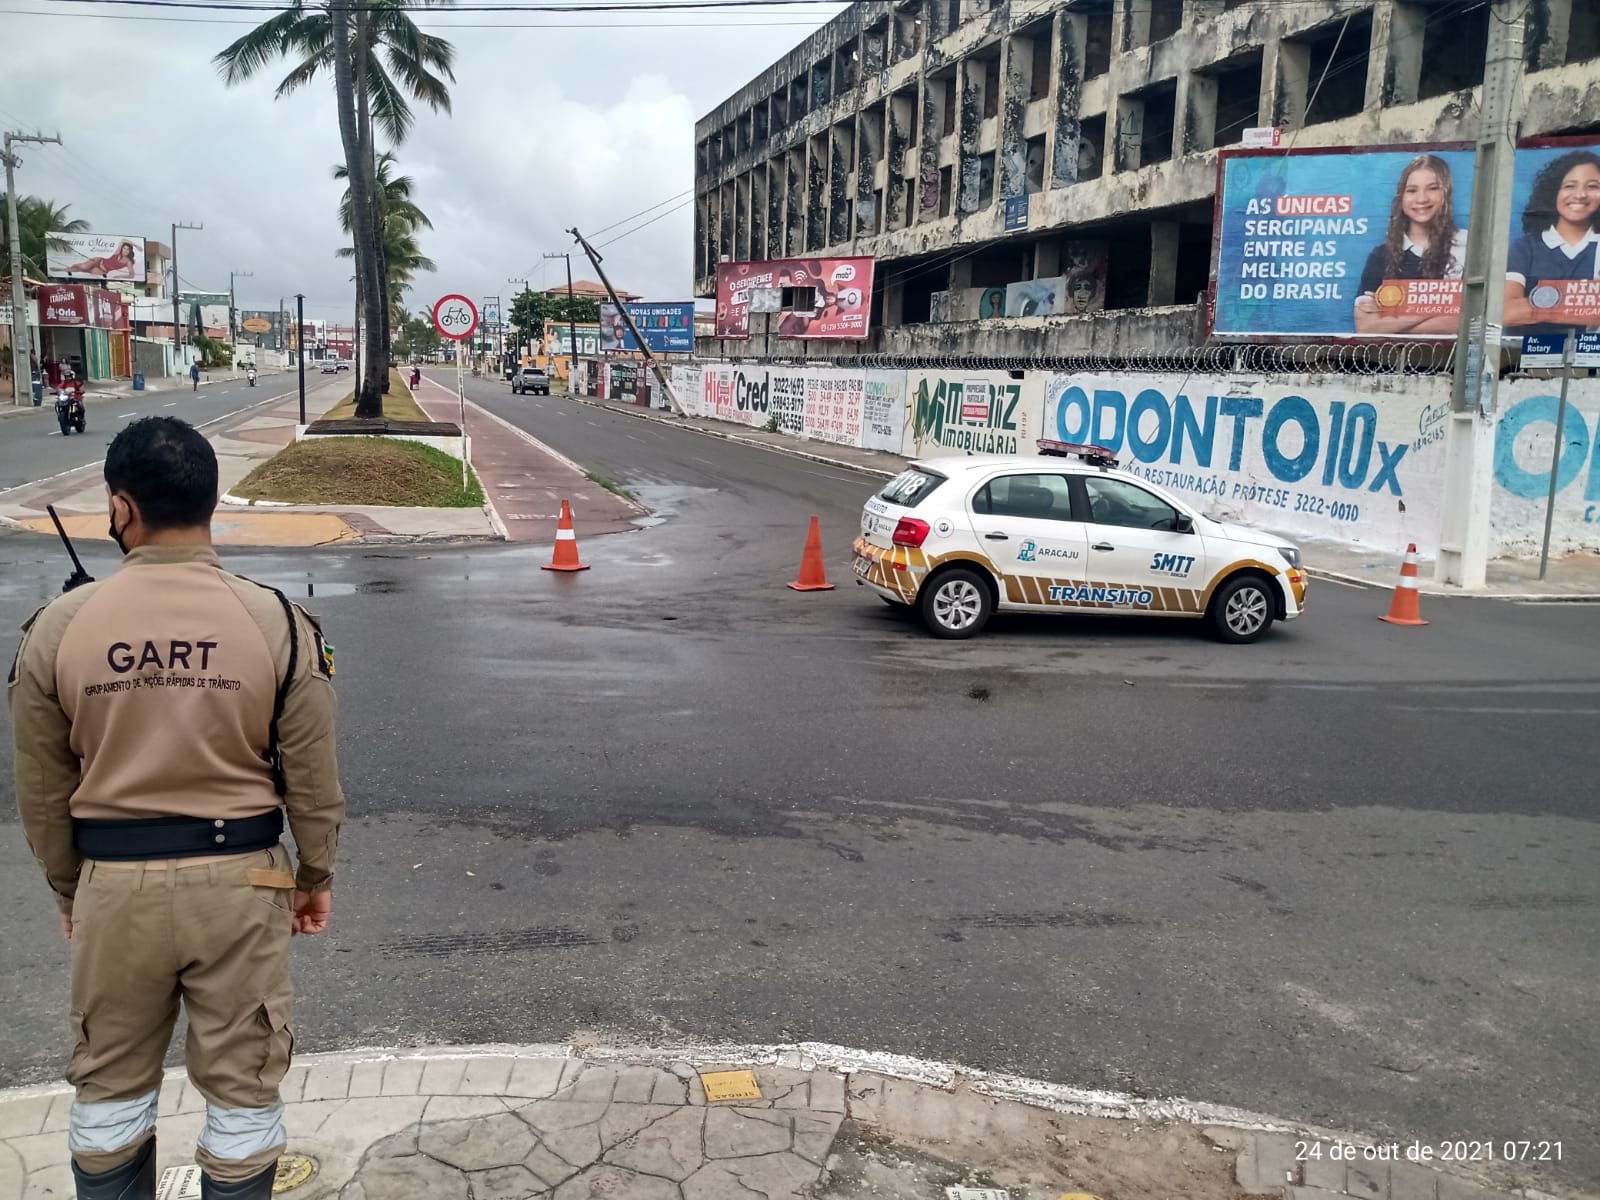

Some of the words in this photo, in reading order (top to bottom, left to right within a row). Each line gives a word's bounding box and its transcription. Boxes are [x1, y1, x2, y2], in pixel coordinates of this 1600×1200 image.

[1246, 198, 1272, 215] AS
[1277, 195, 1351, 214] ÚNICAS
[1245, 218, 1368, 236] SERGIPANAS
[1244, 240, 1305, 257] ENTRE
[1311, 240, 1336, 257] AS
[1241, 261, 1346, 278] MELHORES
[1240, 283, 1268, 300] DO
[1273, 282, 1342, 300] BRASIL
[1407, 294, 1453, 304] DAMM
[1528, 336, 1540, 344] Av.
[1579, 333, 1598, 342] José
[1527, 345, 1551, 354] Rotary
[942, 427, 1017, 454] IMOBILIÁRIA
[1144, 466, 1226, 496] RESTAURAÇÃO
[1232, 481, 1289, 508] PRÓTESE
[1294, 493, 1359, 521] 3222-0010
[1038, 547, 1079, 560] ARACAJU
[1150, 552, 1196, 573] SMTT
[1050, 584, 1153, 605] TRÂNSITO
[107, 640, 218, 673] GART
[85, 680, 131, 697] GRUPAMENTO
[133, 678, 142, 688] DE
[166, 674, 195, 688] RÁPIDAS
[197, 678, 206, 688] DE
[208, 674, 242, 691] TRÂNSITO
